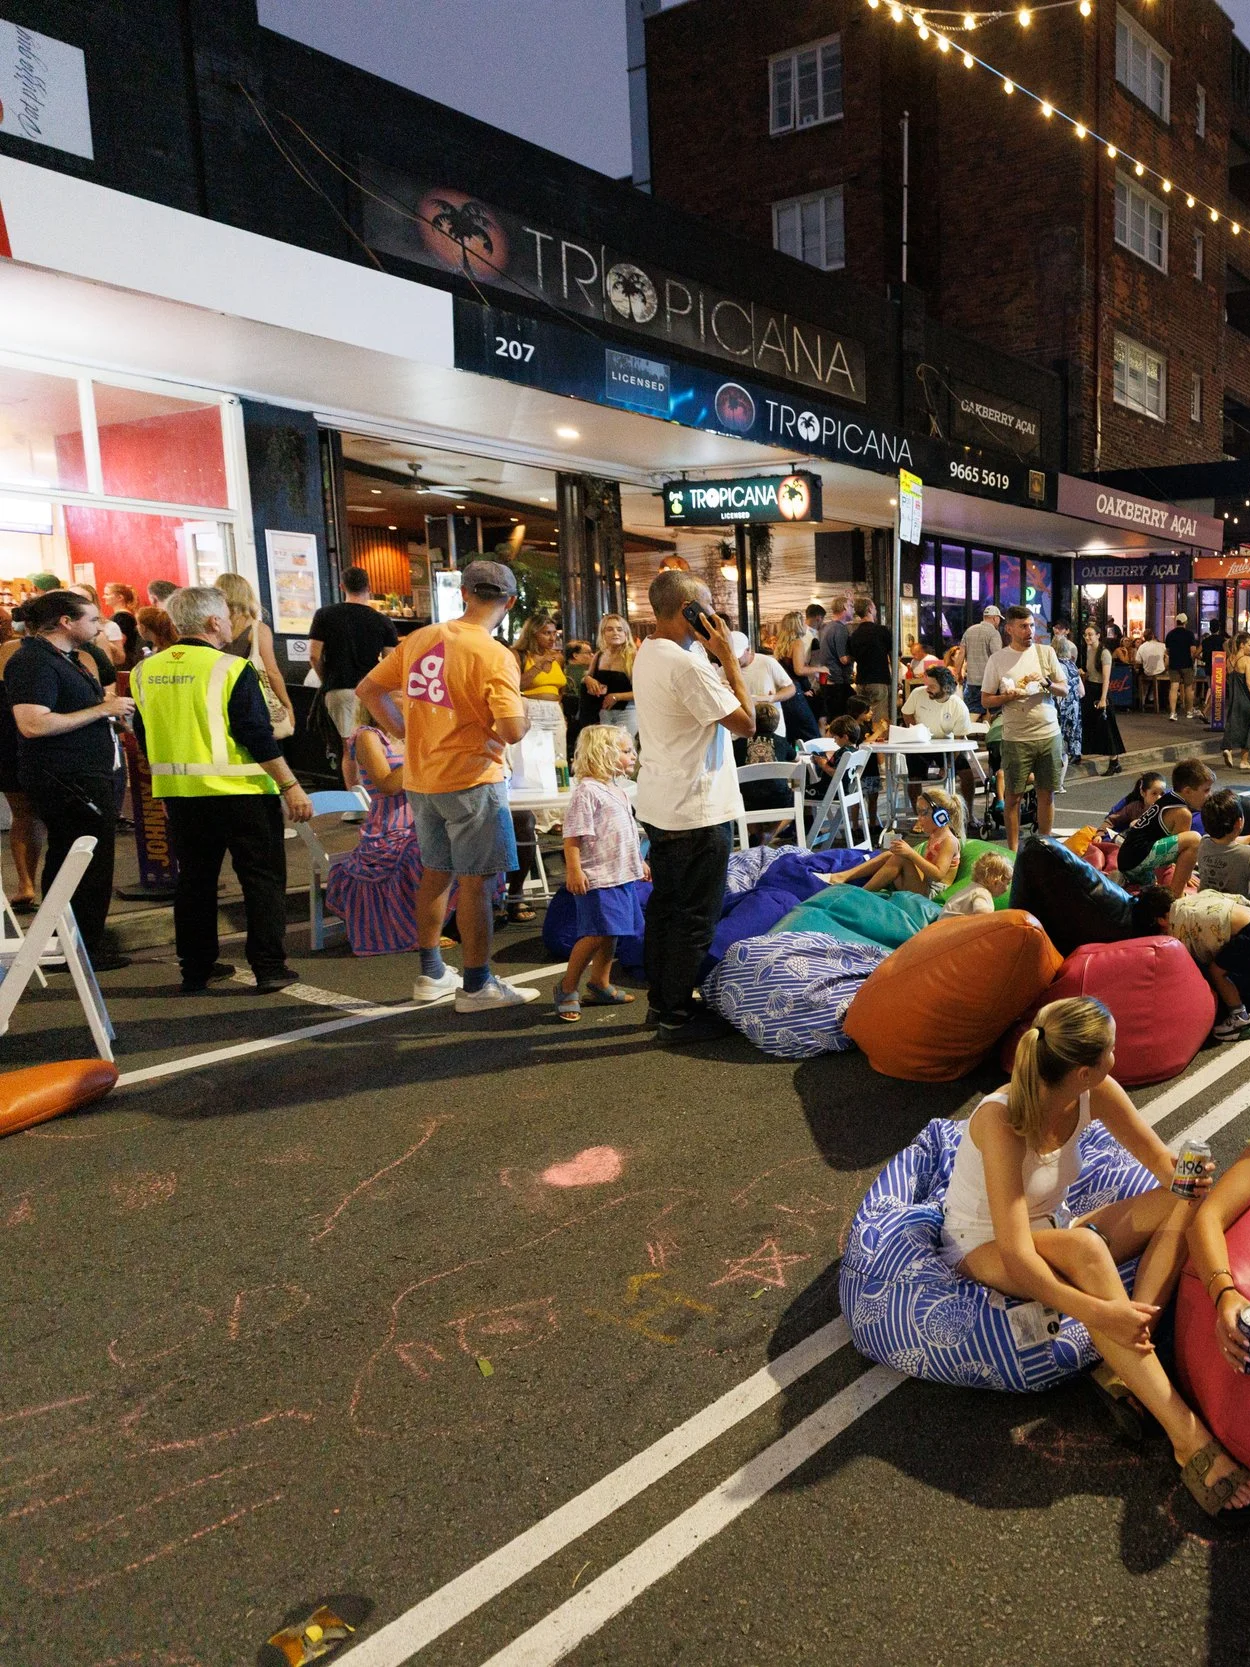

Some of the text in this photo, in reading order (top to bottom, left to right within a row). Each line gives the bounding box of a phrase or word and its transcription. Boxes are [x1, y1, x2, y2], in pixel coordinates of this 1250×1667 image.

[522, 226, 856, 392] TROPICANA
[495, 336, 535, 362] 207
[611, 370, 665, 393] LICENSED
[961, 400, 1015, 428] OAKBERRY
[765, 400, 914, 467] TROPICANA
[950, 461, 1010, 490] 9665 5619
[689, 485, 779, 509] TROPICANA
[1096, 494, 1198, 538] OAKBERRY AÇAI
[1081, 563, 1181, 578] OAKBERRY AÇAI
[147, 675, 196, 685] SECURITY
